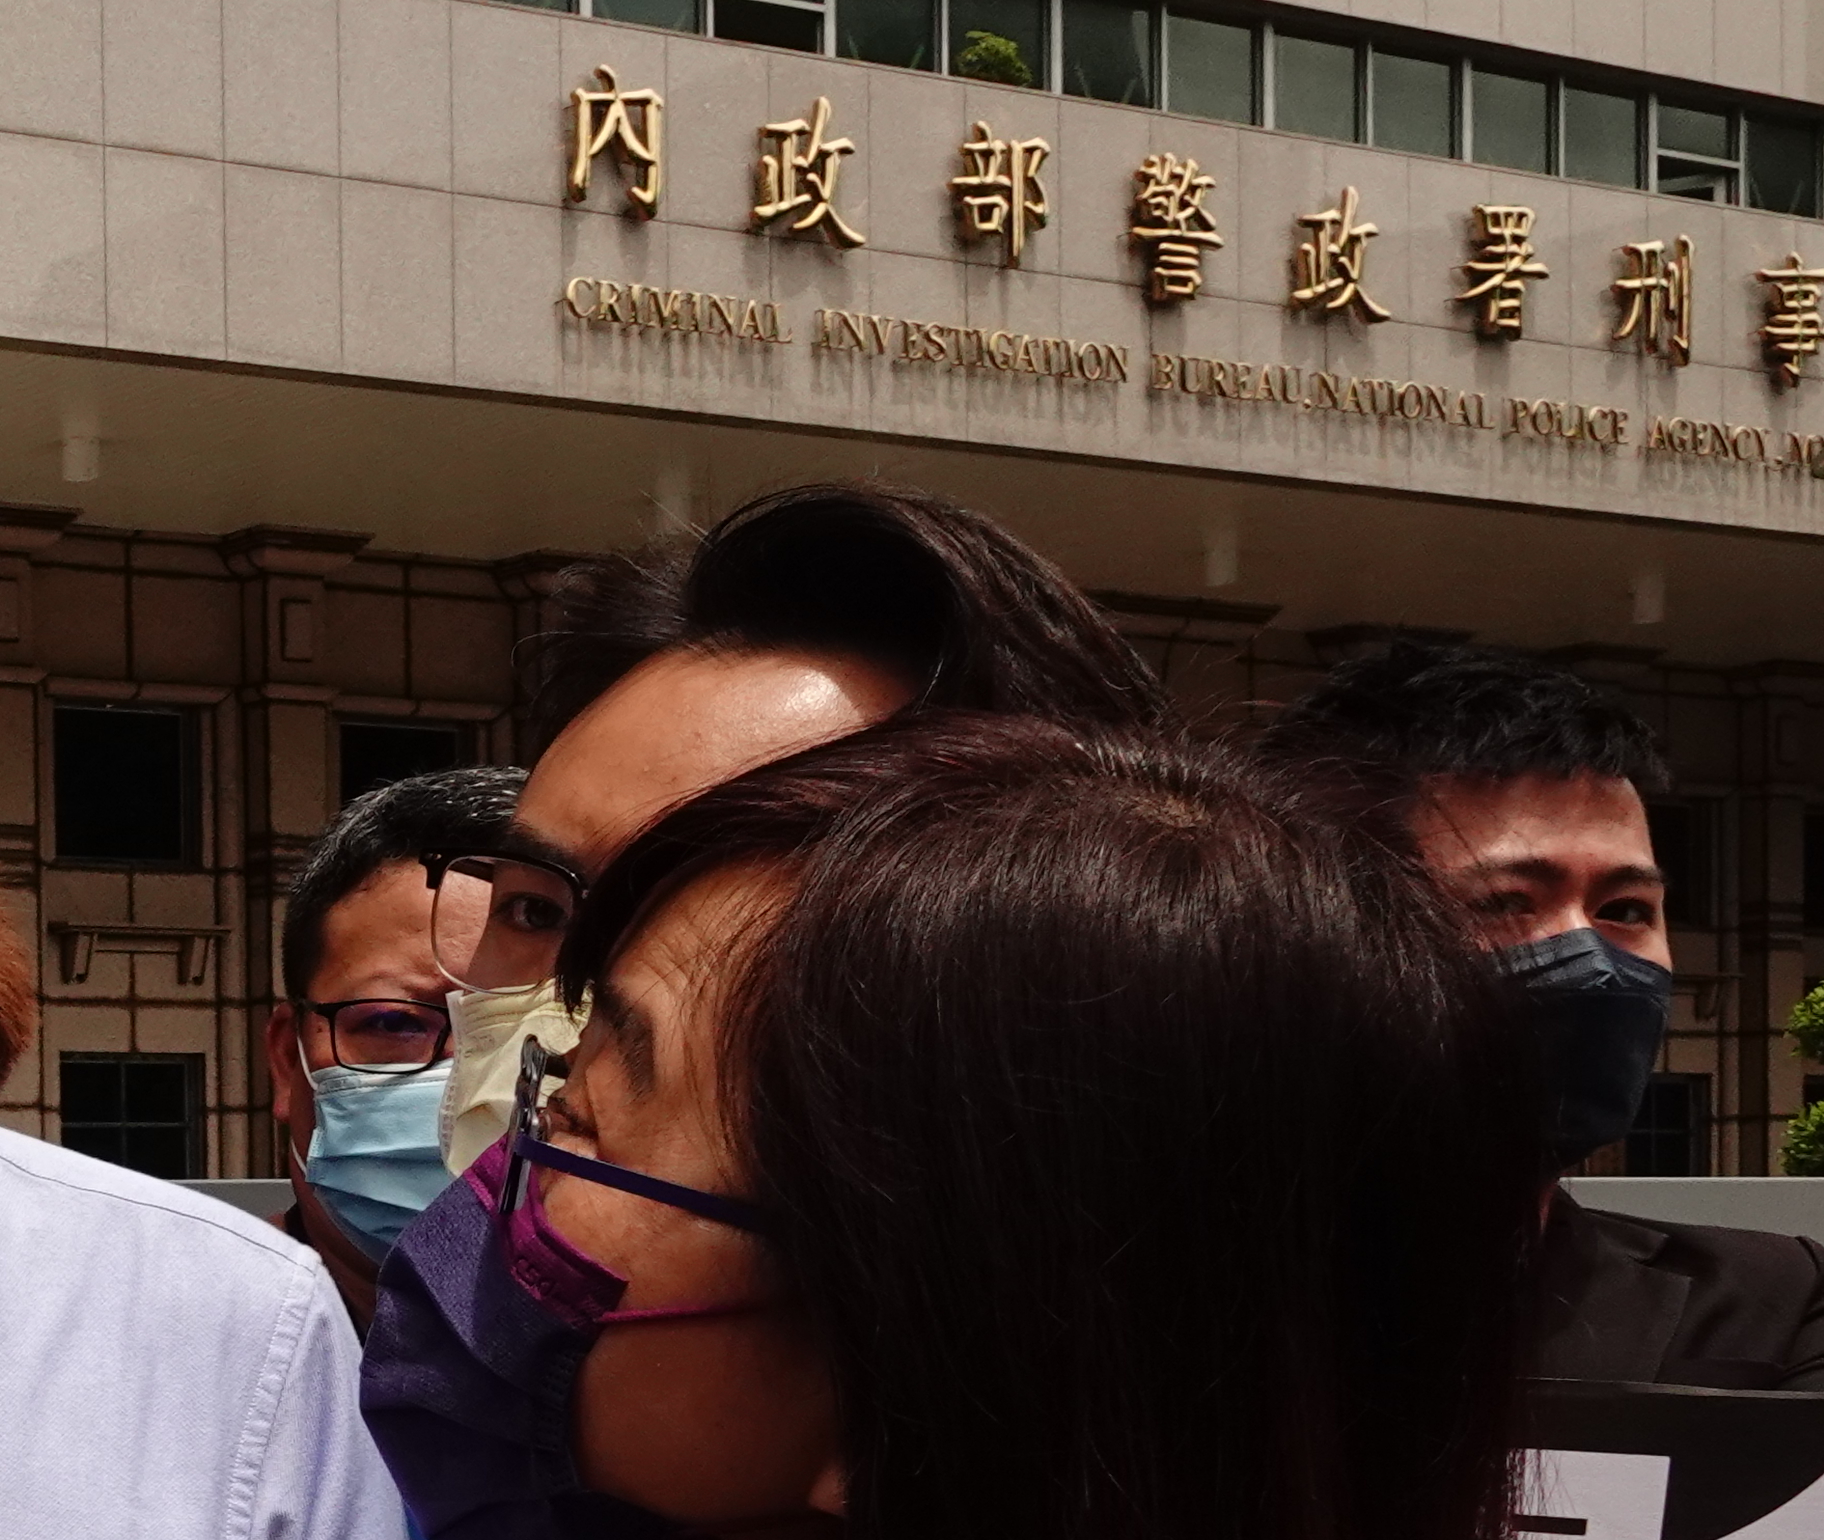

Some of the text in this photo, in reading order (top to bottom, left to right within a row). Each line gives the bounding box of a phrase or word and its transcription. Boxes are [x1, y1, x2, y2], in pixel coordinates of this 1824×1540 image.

[565, 275, 793, 345] CRIMINAL
[812, 307, 1131, 384] INVESTIGATION
[1504, 398, 1630, 446] POLICE
